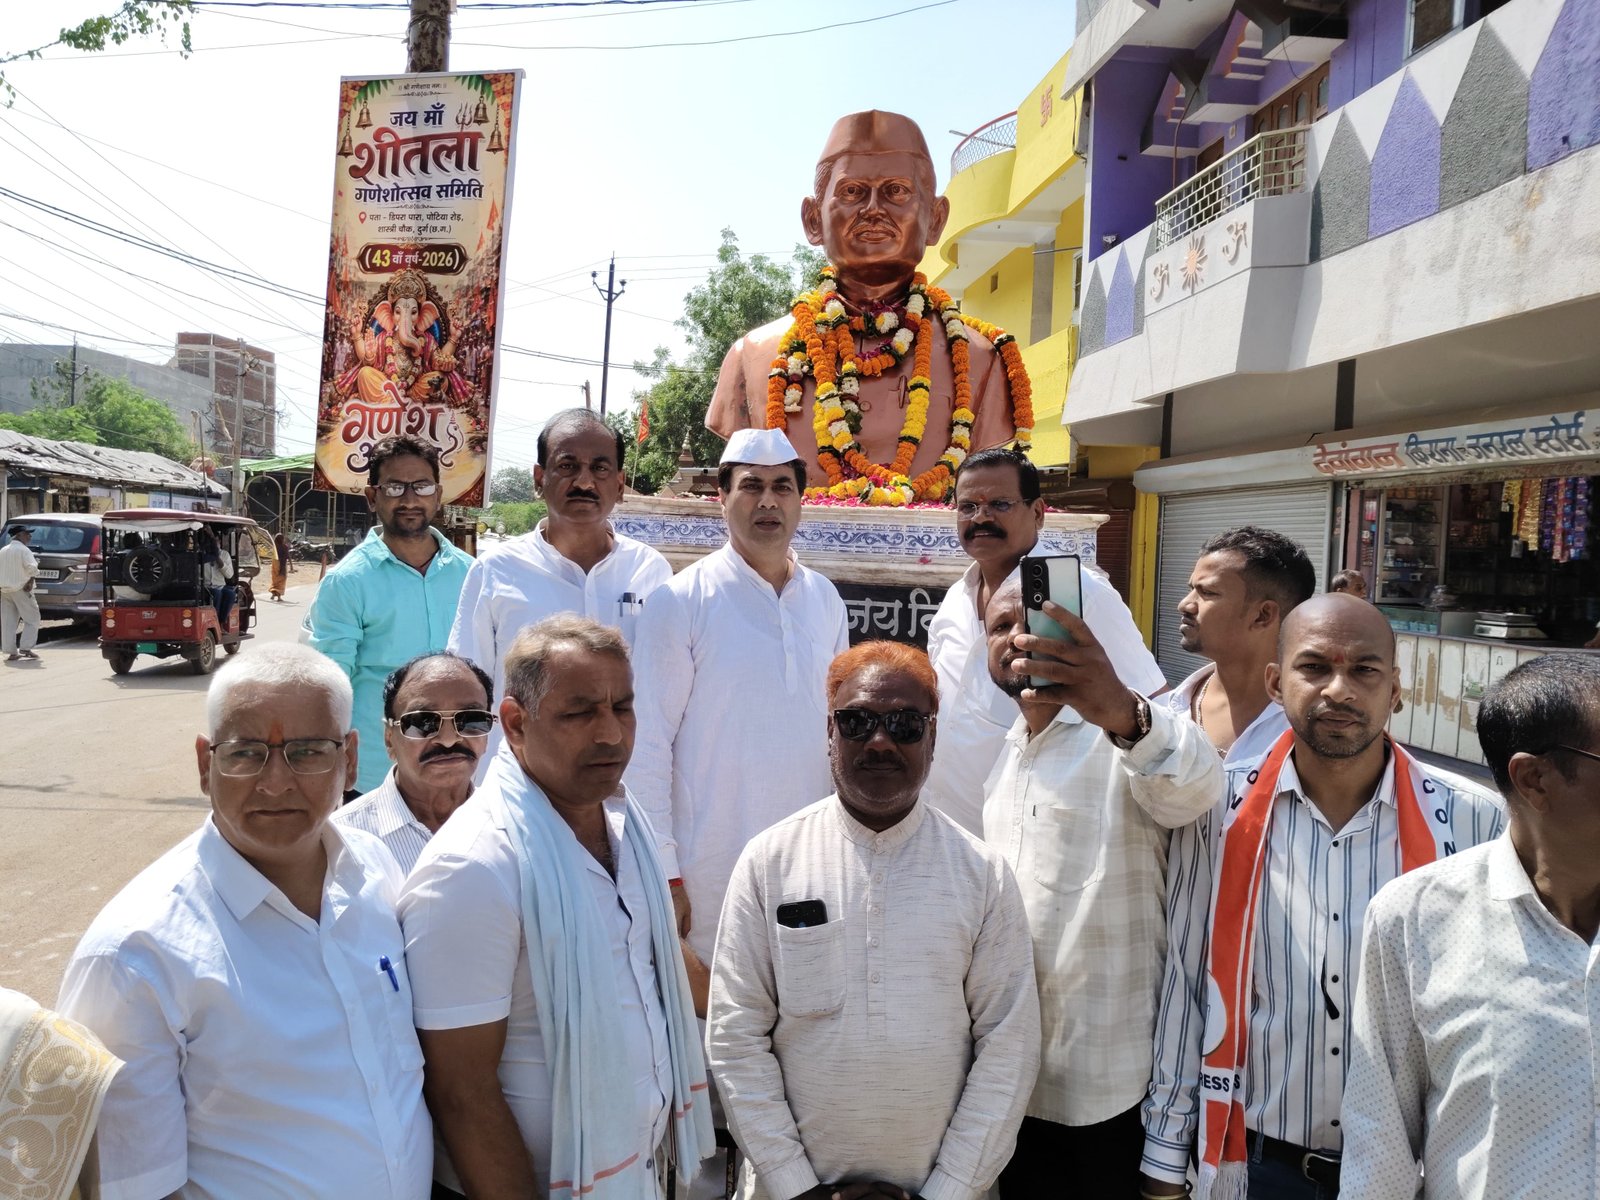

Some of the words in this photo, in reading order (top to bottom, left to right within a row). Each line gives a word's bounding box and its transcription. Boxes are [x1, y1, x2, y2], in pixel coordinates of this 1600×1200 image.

[390, 111, 418, 127] जय
[424, 102, 446, 126] माँ
[349, 127, 486, 185] शीतला
[355, 182, 432, 203] गणेशोत्सव
[436, 178, 484, 198] समिति
[377, 223, 397, 233] शास्त्री
[398, 224, 415, 234] चौक,
[408, 213, 424, 222] पारा,
[426, 211, 448, 221] पोटिया
[341, 380, 445, 444] गणेश
[1405, 433, 1466, 466] किराना
[1466, 428, 1535, 459] जनरल
[1529, 410, 1591, 454] स्टोर्स
[844, 597, 903, 637] जय
